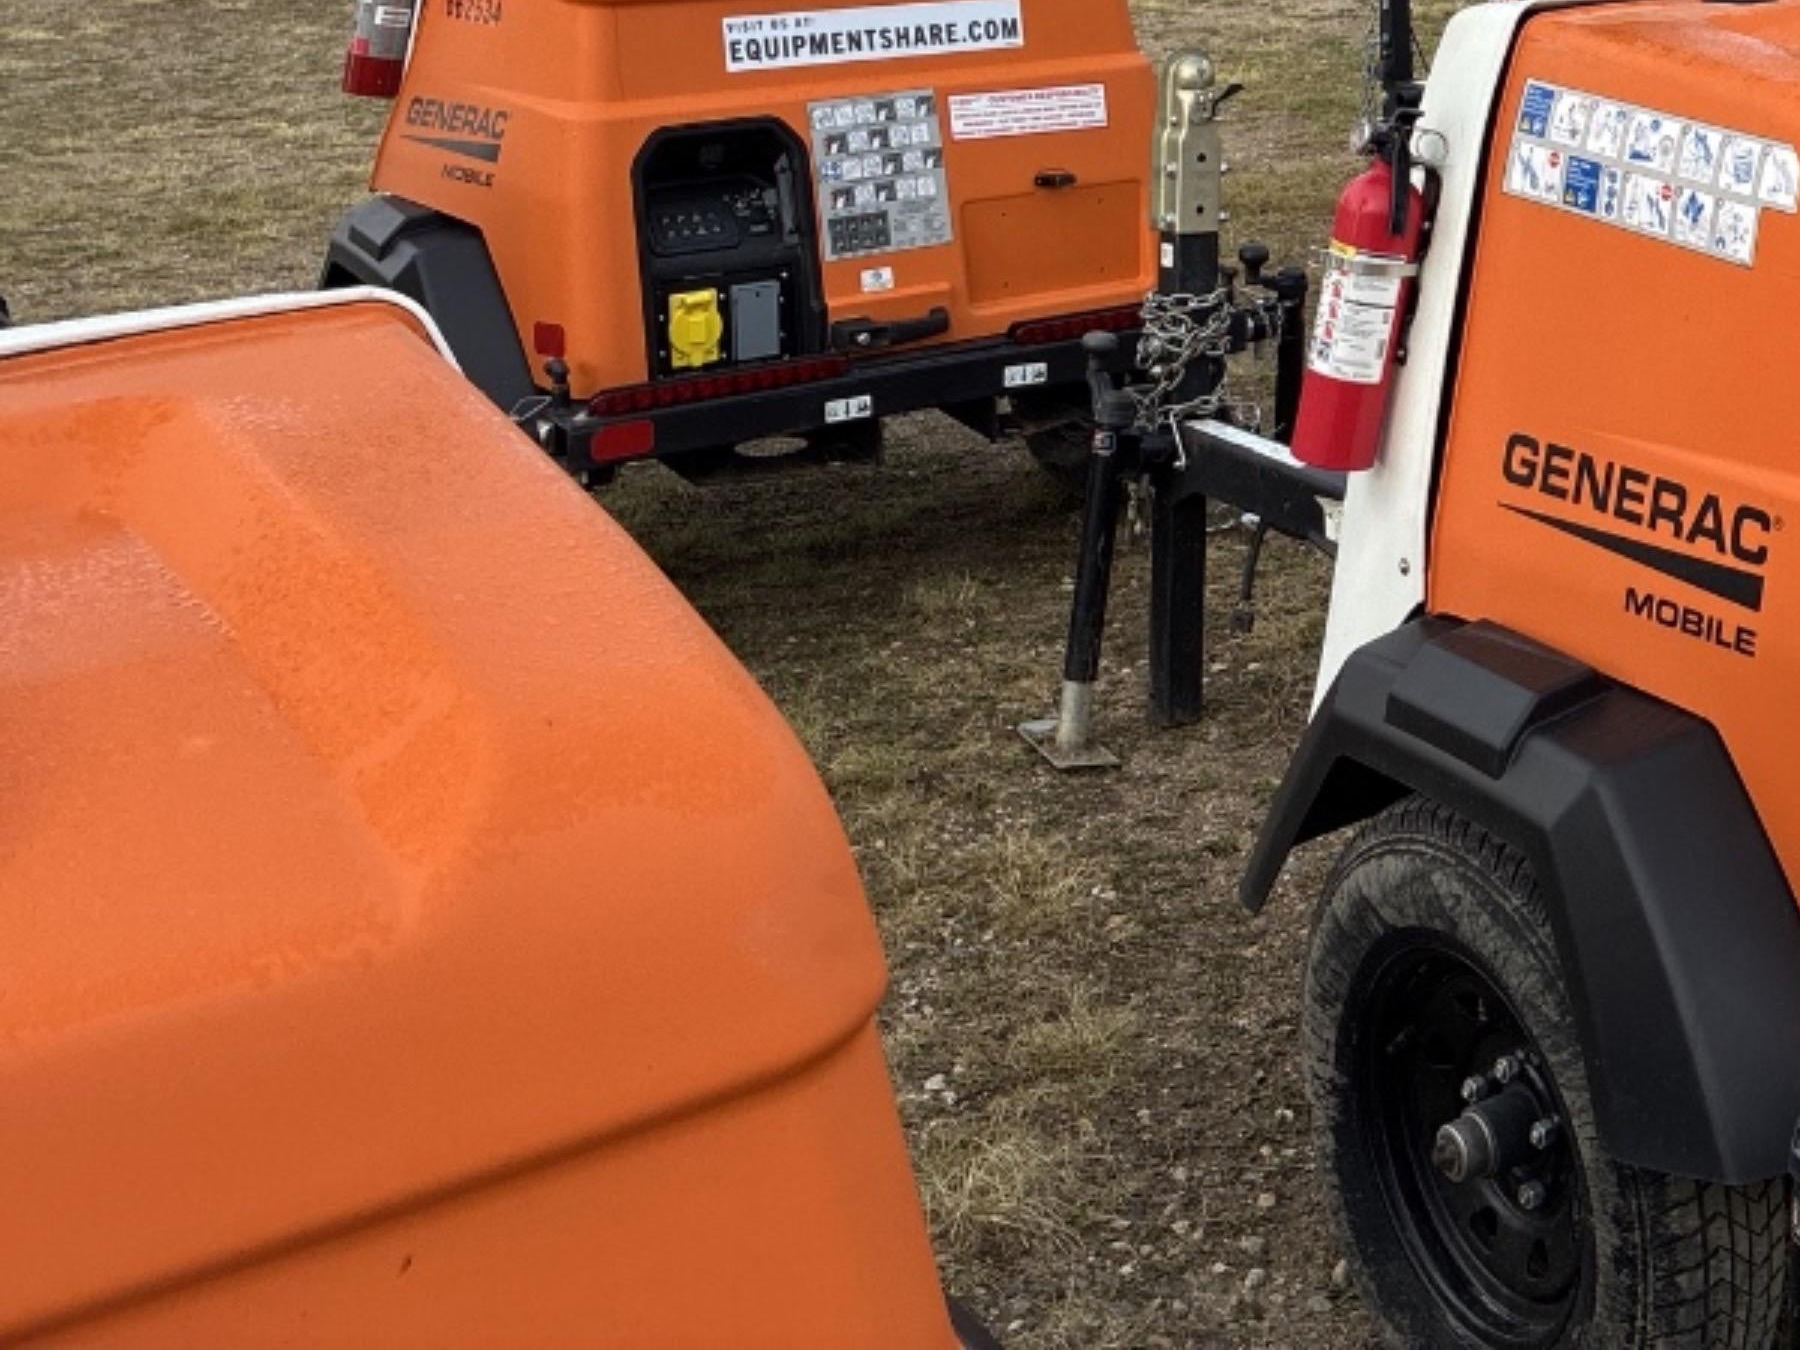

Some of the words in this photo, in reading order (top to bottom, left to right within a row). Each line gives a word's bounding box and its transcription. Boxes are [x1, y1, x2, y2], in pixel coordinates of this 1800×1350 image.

[729, 17, 1019, 64] EQUIPMENTSHARE.COM
[405, 95, 509, 139] GENERAC
[1502, 432, 1771, 565] GENERAC
[1625, 587, 1758, 658] MOBILE
